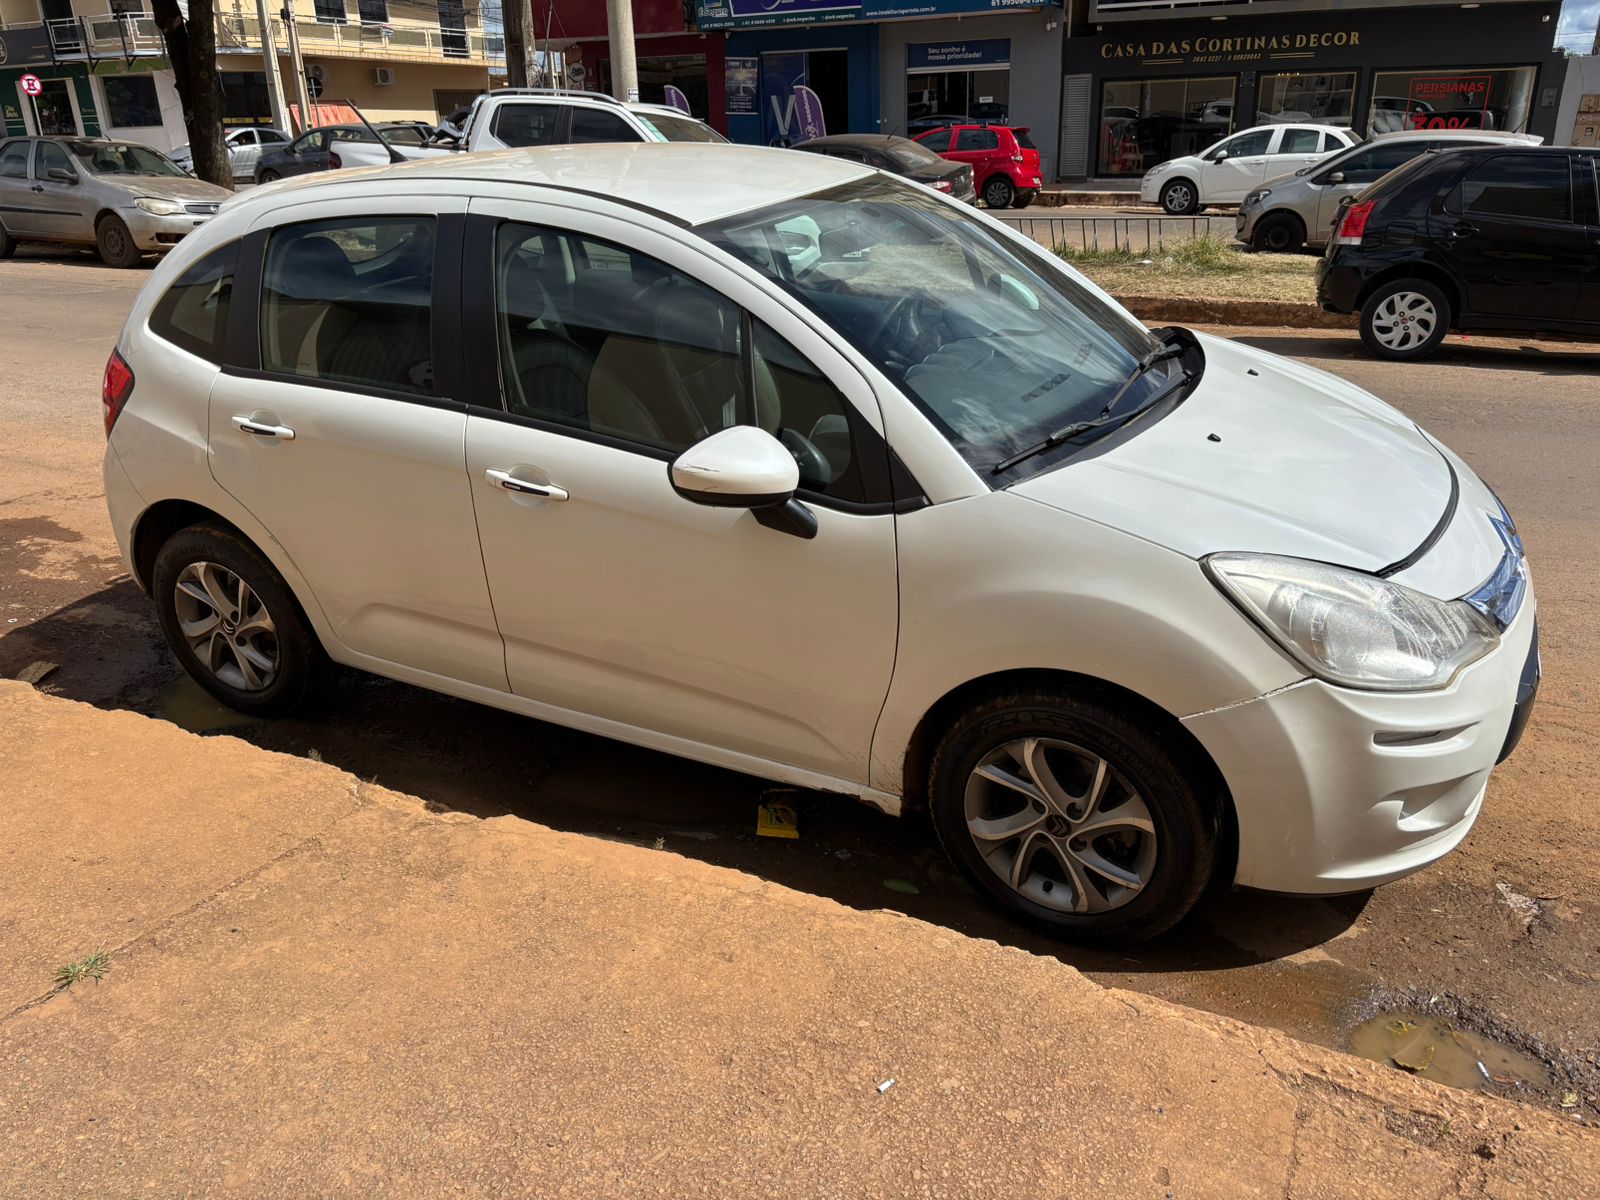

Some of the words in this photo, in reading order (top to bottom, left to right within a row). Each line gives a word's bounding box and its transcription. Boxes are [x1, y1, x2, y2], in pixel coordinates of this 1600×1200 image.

[703, 7, 729, 18] Seguro
[941, 46, 961, 54] sonho
[1101, 43, 1146, 59] CASA
[1151, 40, 1191, 55] DAS
[1194, 34, 1290, 53] CORTINAS
[1295, 31, 1360, 48] DECOR
[946, 52, 982, 61] prioridade!
[1415, 82, 1486, 94] PERSIANAS
